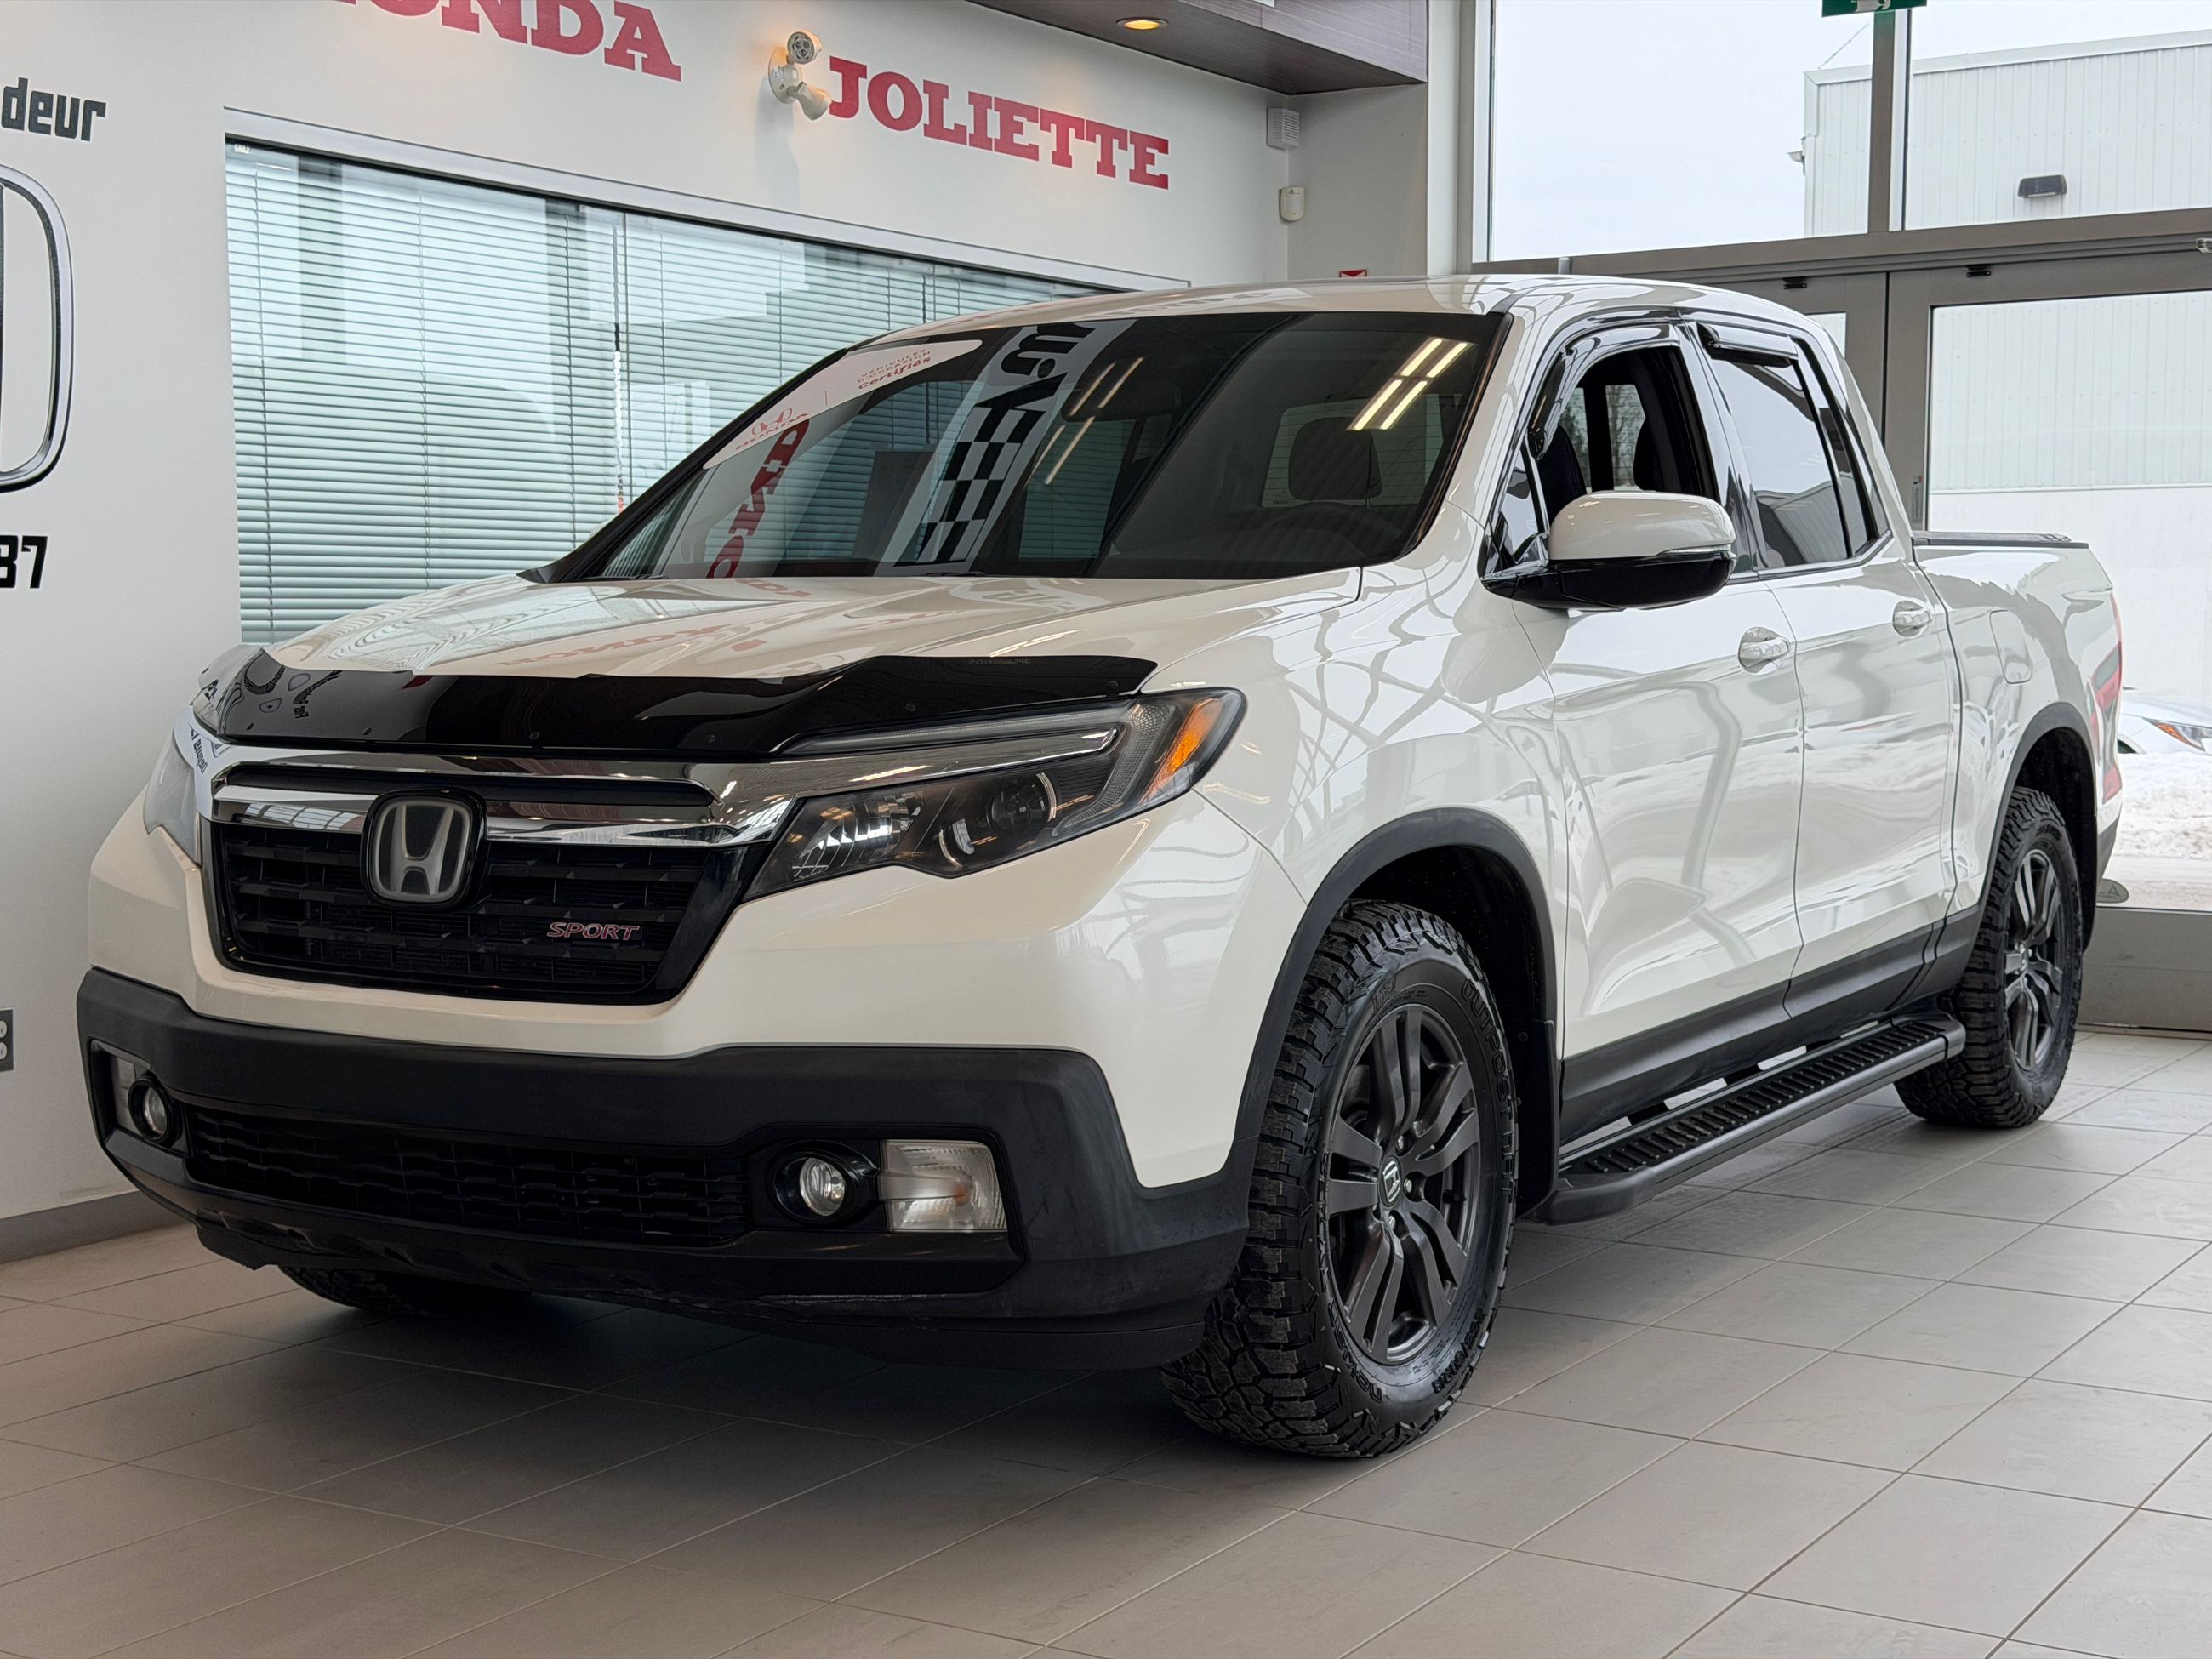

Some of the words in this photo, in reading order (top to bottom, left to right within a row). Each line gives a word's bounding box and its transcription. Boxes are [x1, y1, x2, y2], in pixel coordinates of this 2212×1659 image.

[1, 77, 106, 142] deur
[334, 0, 681, 82] NDA
[830, 56, 1169, 190] JOLIETTE
[547, 922, 640, 940] SPORT
[1461, 978, 1513, 1120] OUTPOST
